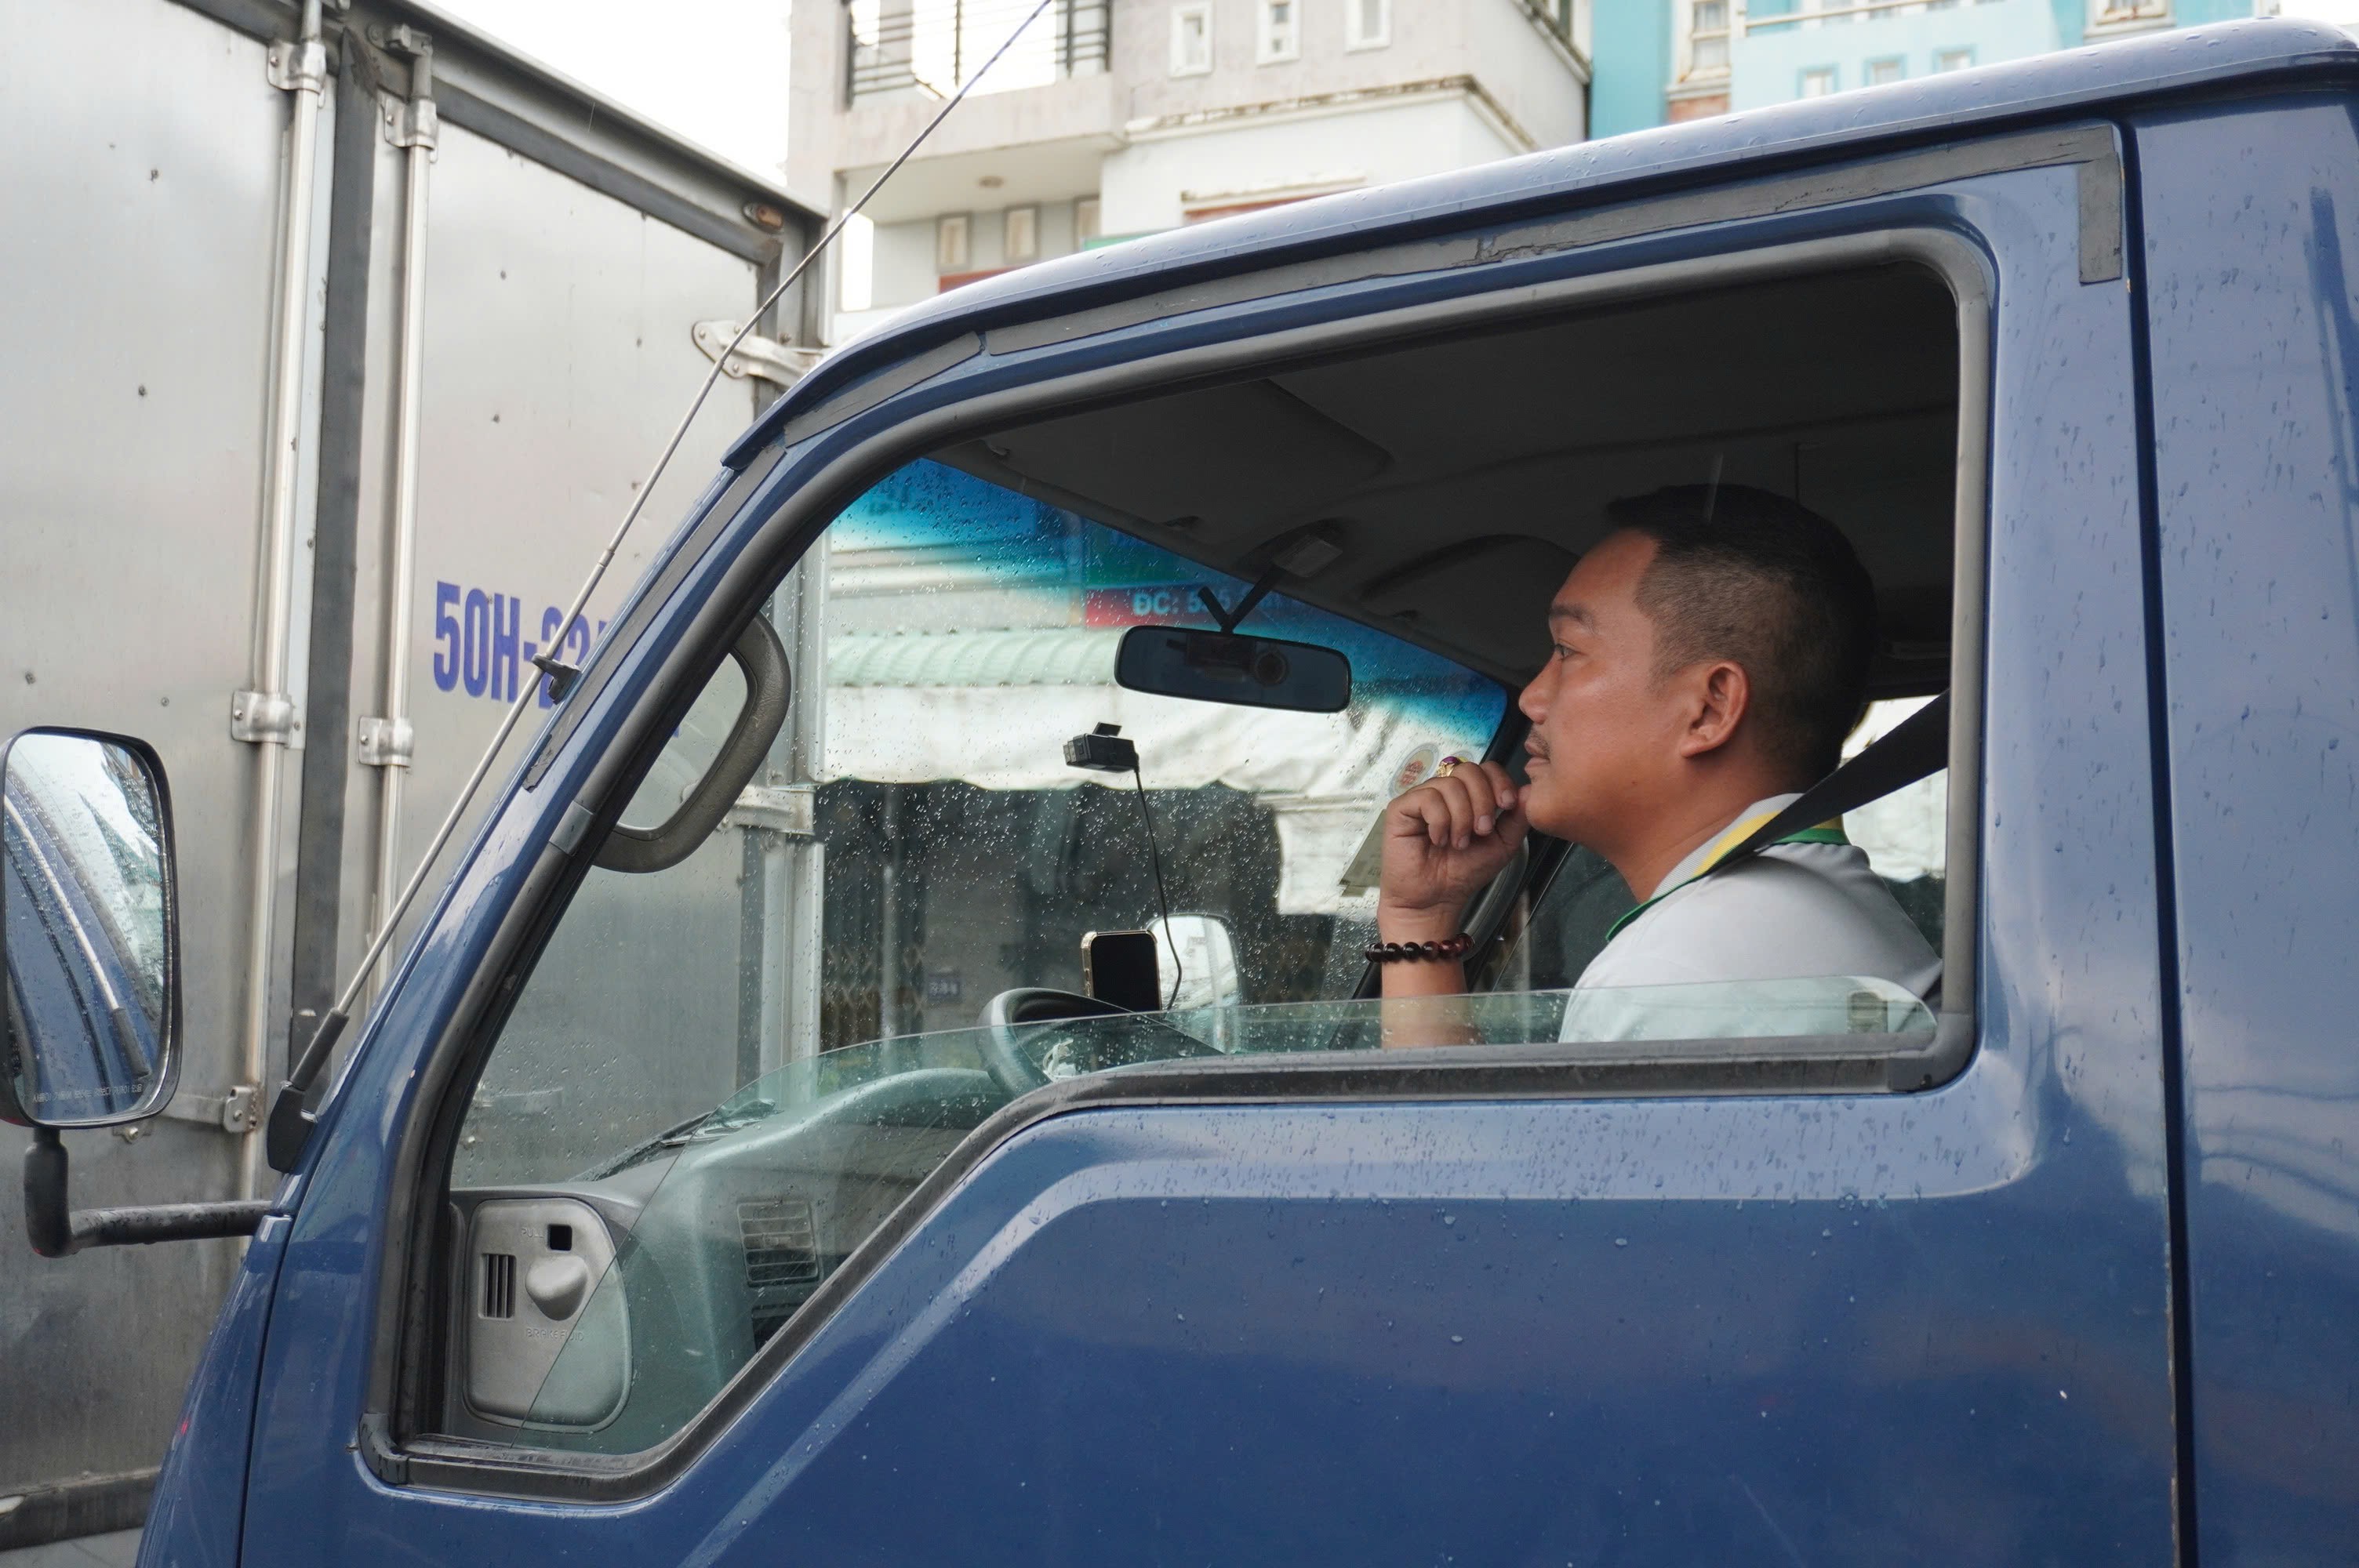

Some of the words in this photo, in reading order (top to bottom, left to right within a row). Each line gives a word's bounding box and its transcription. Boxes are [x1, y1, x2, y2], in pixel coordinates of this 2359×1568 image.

[434, 581, 611, 710] 50H-22
[521, 1227, 544, 1238] PULL
[526, 1328, 558, 1338] BRAKE
